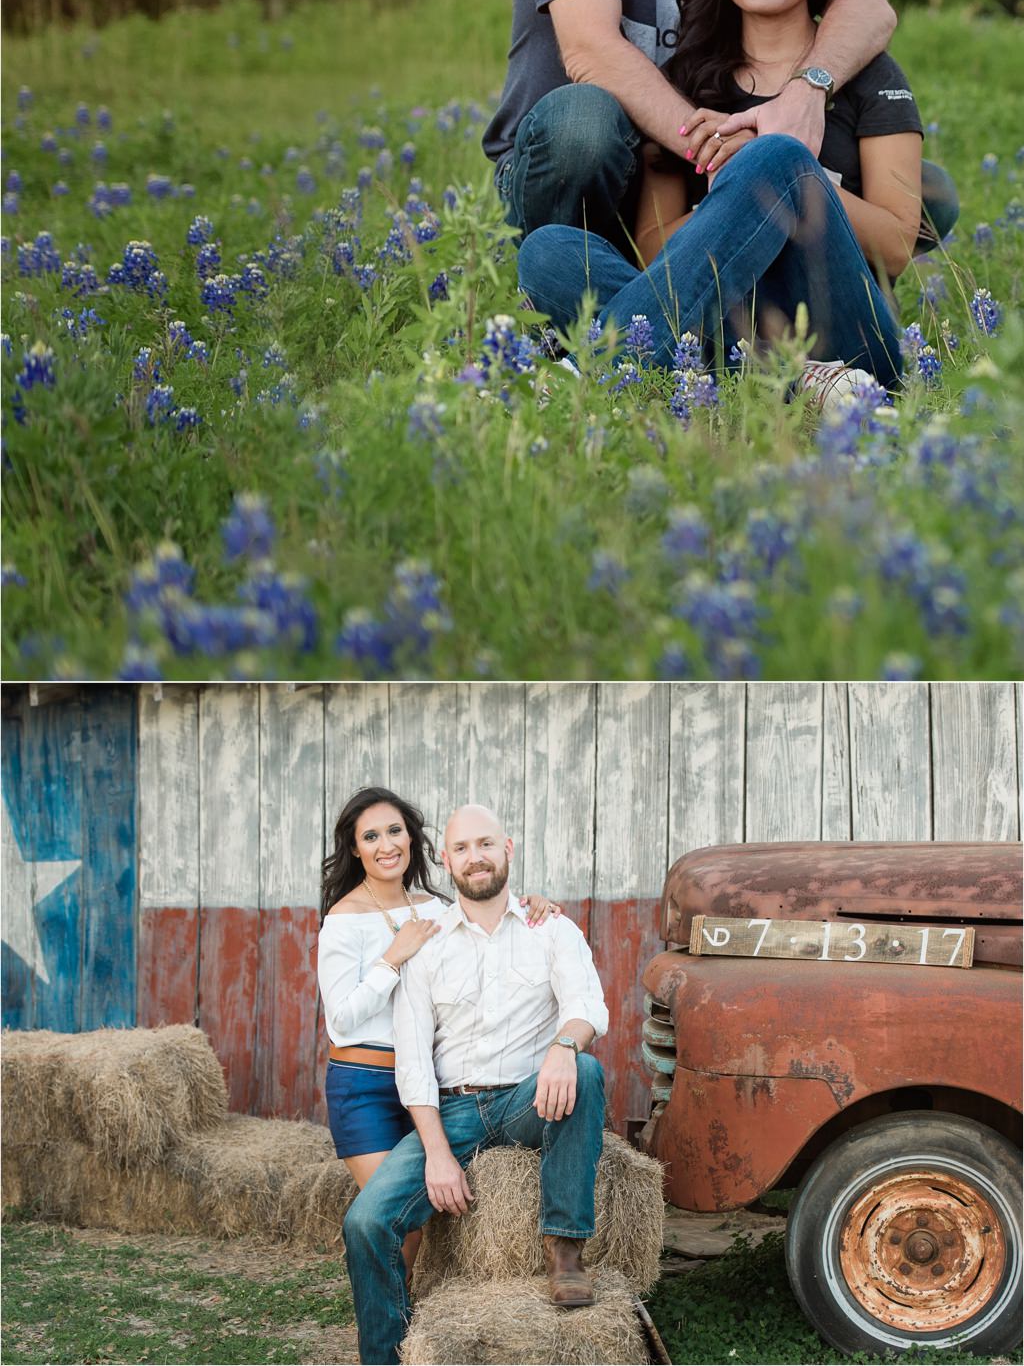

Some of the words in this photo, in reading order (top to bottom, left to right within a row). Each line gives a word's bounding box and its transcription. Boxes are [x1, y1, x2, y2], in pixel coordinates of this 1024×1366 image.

[747, 918, 772, 956] 7
[817, 922, 867, 962] 13
[917, 927, 966, 965] 17
